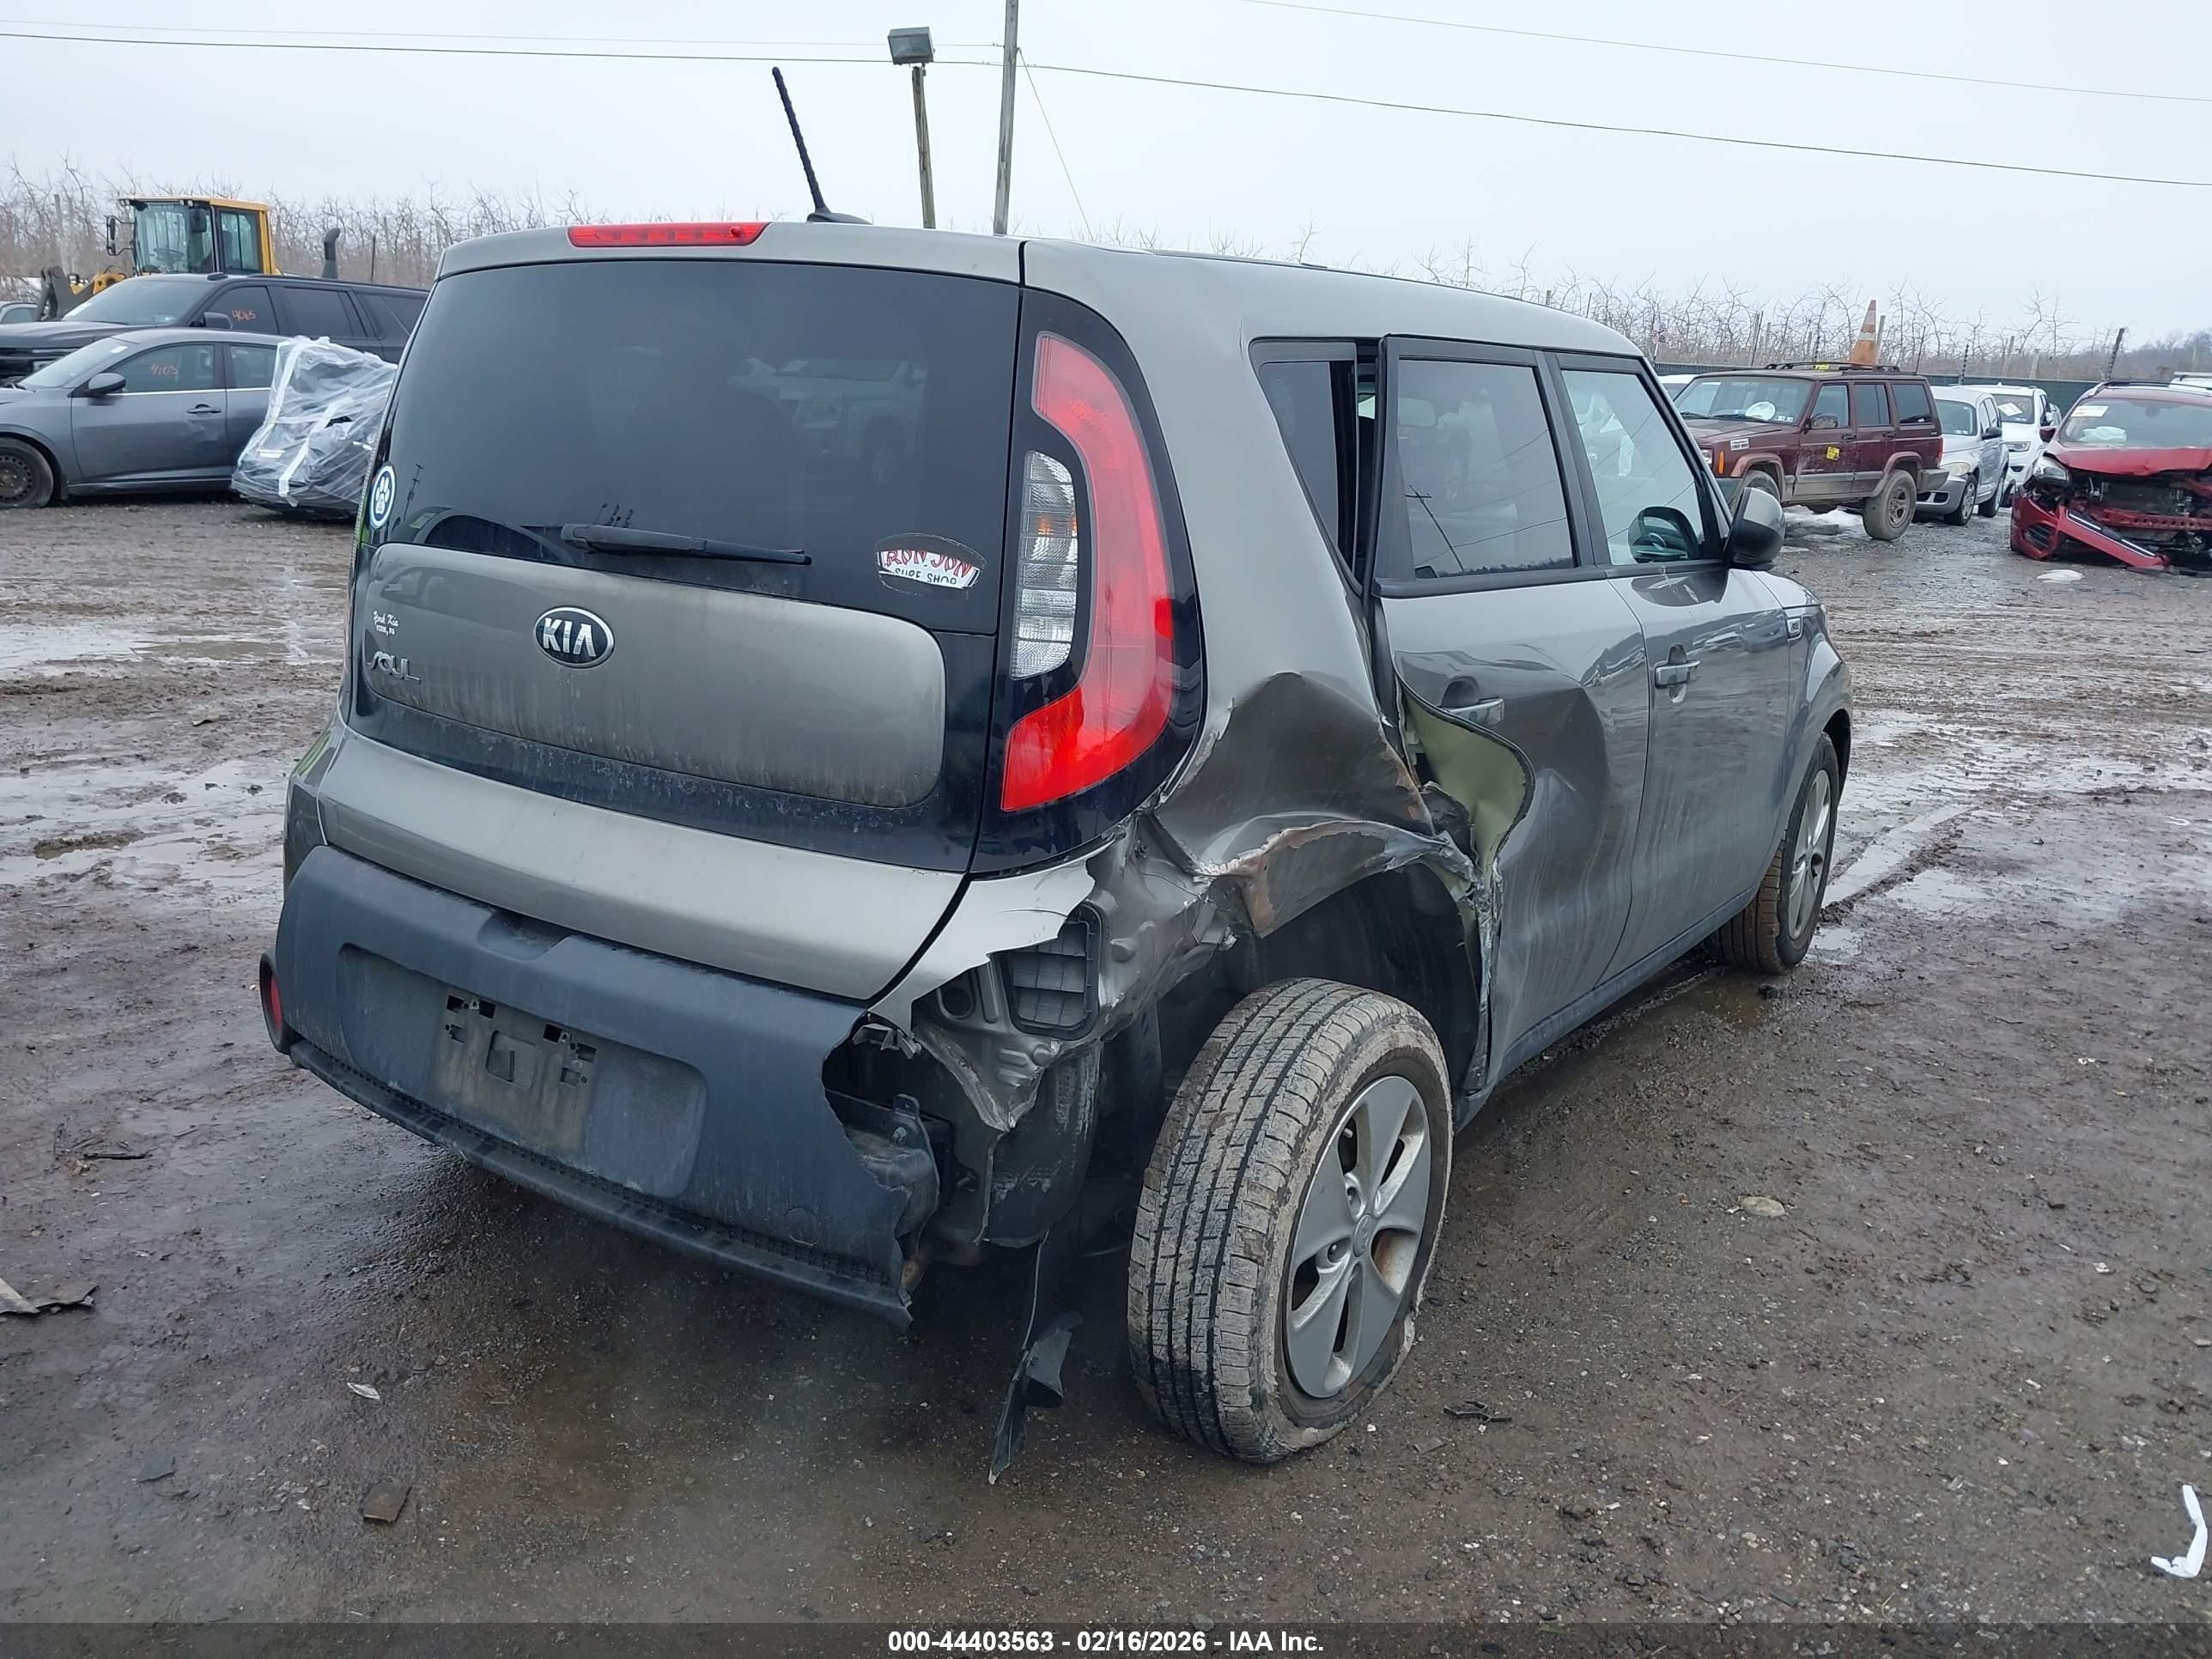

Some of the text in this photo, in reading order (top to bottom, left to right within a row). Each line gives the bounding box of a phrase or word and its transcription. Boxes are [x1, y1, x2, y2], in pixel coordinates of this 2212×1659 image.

[885, 549, 972, 578] RON JON
[386, 613, 399, 627] Kia
[542, 617, 597, 658] KIA
[366, 650, 421, 683] SOUL
